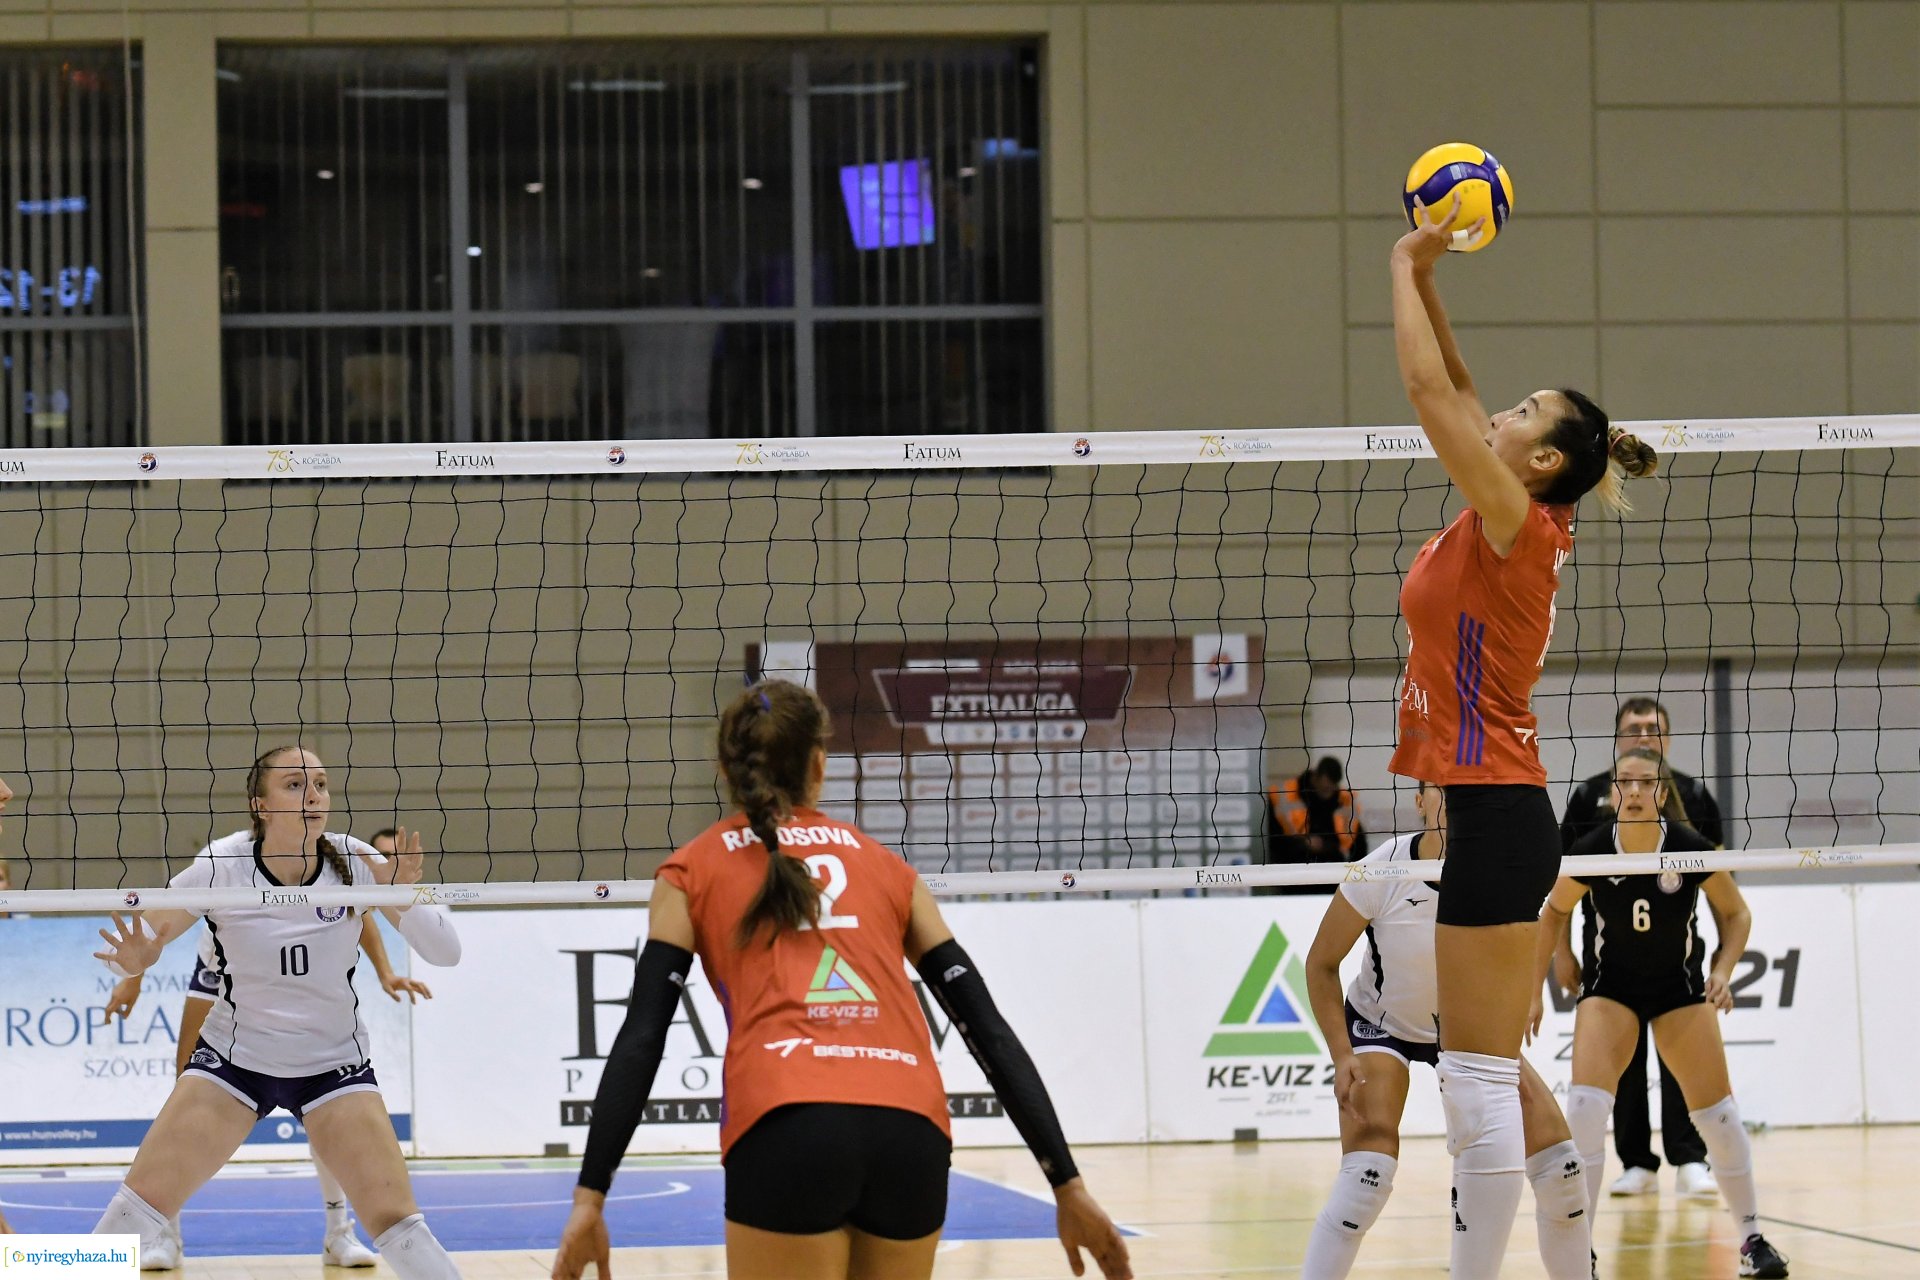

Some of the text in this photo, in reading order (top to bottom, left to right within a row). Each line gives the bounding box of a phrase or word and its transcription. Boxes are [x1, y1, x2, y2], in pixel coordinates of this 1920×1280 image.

[931, 693, 1078, 718] EXTRALIGA
[721, 826, 861, 852] RAOSOVA
[1632, 898, 1651, 933] 6
[280, 944, 309, 976] 10
[97, 974, 190, 993] MGYAR
[6, 997, 178, 1047] RÖPLA
[808, 1006, 879, 1019] KE-VIZ 21
[1207, 1064, 1315, 1088] KE-VIZ
